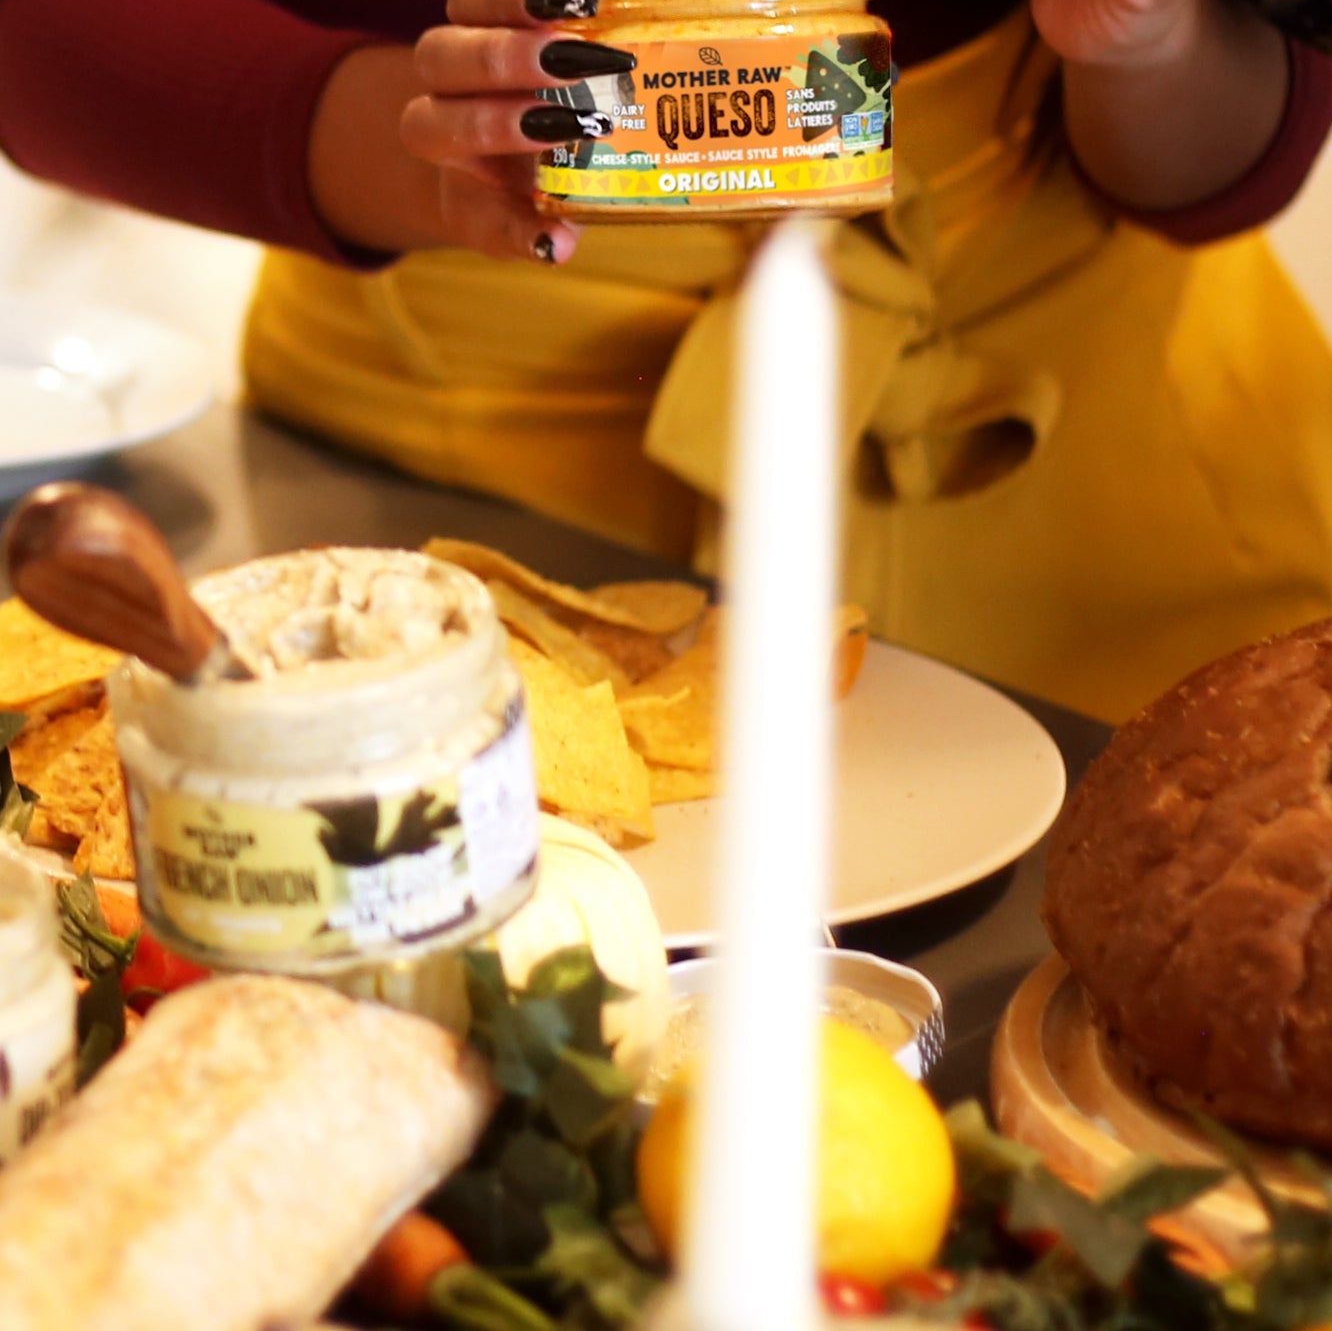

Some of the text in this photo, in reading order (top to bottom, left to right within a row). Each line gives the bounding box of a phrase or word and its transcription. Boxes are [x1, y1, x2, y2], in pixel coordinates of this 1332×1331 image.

[643, 66, 782, 89] MOTHER RAW
[786, 88, 815, 100] SANS
[613, 104, 646, 116] DAIRY
[787, 100, 836, 114] PRODUITS
[621, 119, 646, 130] FREE
[656, 89, 776, 151] QUESO
[553, 148, 575, 168] 250 g
[591, 153, 661, 166] CHEESE-STYLE
[665, 152, 700, 164] SAUCE
[708, 150, 743, 162] SAUCE
[747, 147, 778, 160] STYLE
[658, 169, 775, 193] ORIGINAL
